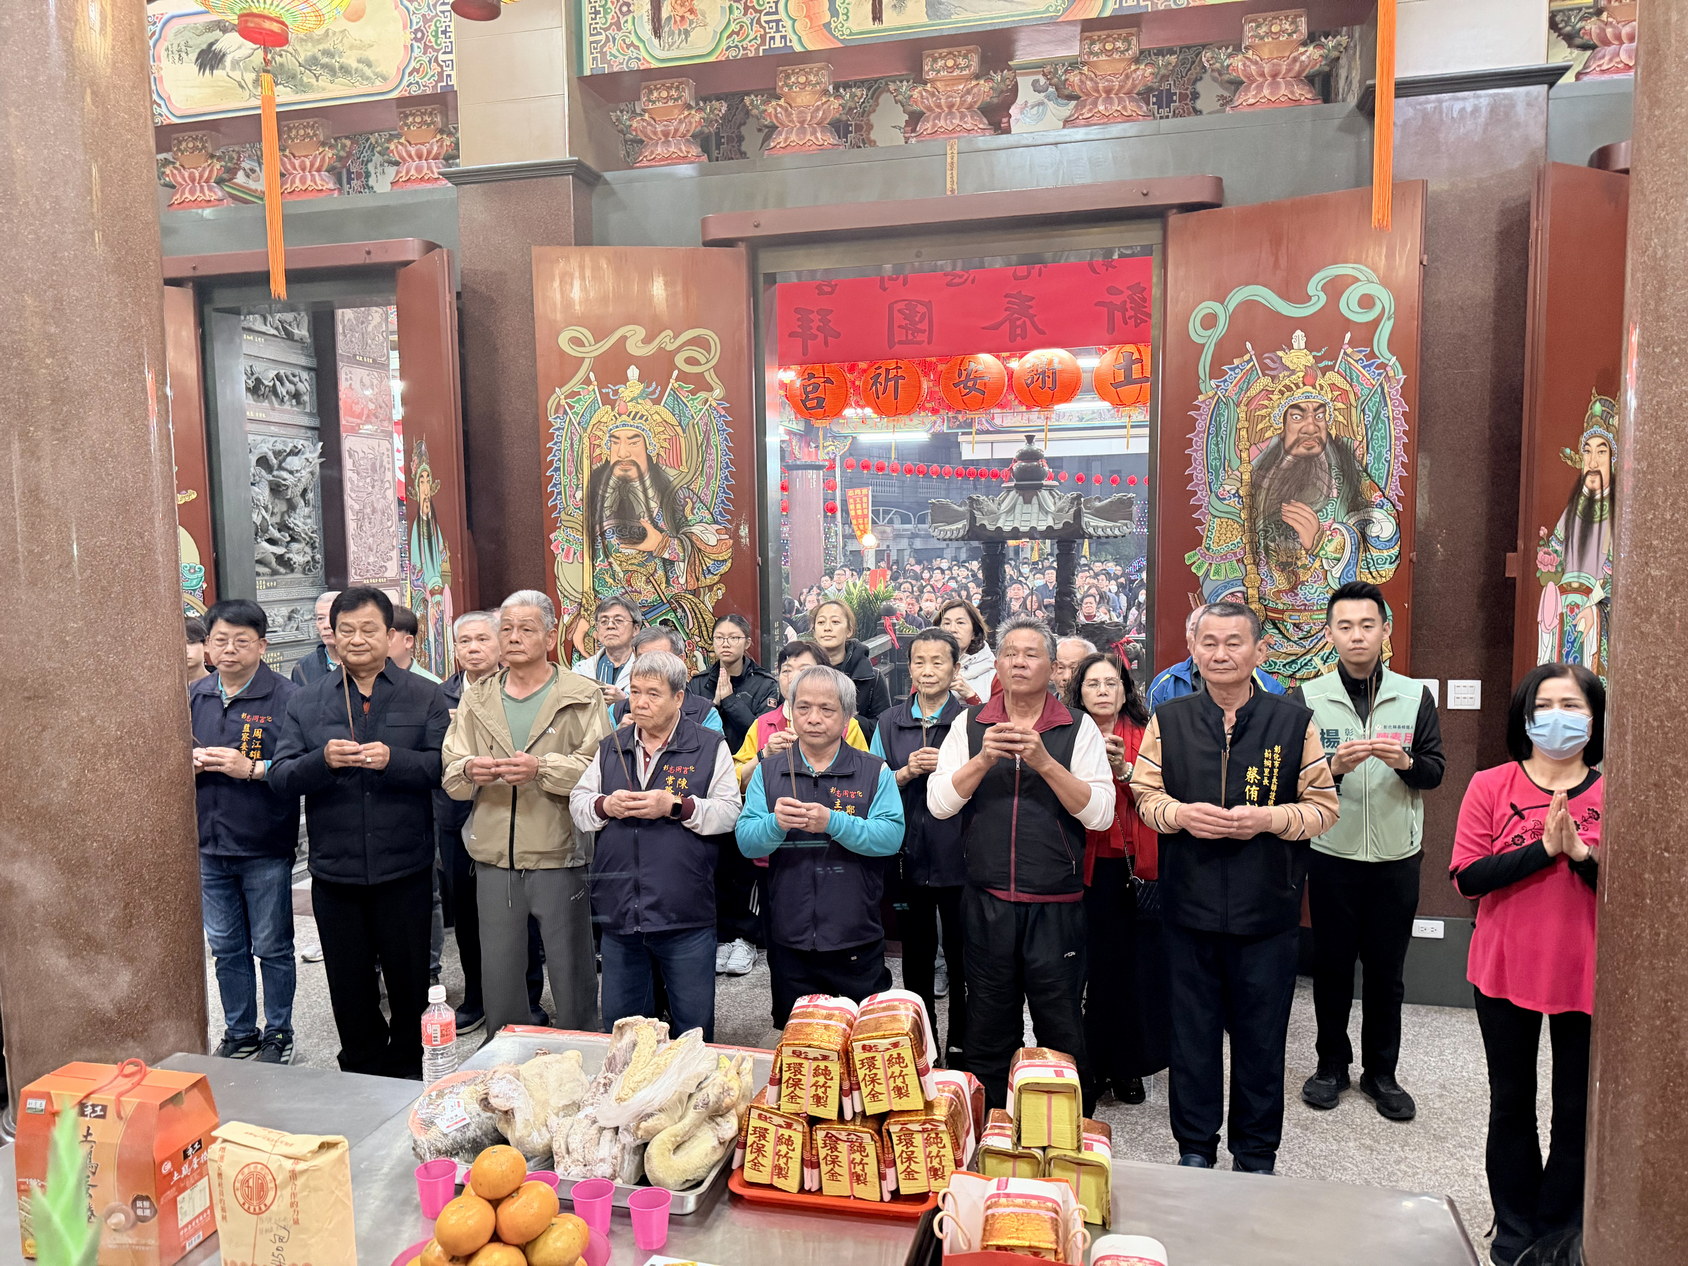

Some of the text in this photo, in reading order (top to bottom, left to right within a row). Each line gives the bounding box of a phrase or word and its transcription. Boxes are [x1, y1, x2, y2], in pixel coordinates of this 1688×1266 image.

[799, 372, 835, 411] 宮
[868, 365, 906, 400] 祈
[953, 360, 990, 397] 安
[1024, 355, 1062, 391] 謝
[1110, 351, 1151, 389] 土
[1245, 766, 1261, 807] 蔡侑
[783, 1061, 806, 1105] 環保金
[810, 1064, 834, 1109] 純竹製
[858, 1055, 885, 1103] 環保金
[886, 1053, 911, 1100] 純竹製
[747, 1125, 770, 1173] 環保金
[773, 1132, 796, 1180] 純竹製
[820, 1136, 844, 1182] 環保金
[849, 1139, 870, 1186] 純竹製
[895, 1132, 922, 1181] 環保金
[924, 1132, 947, 1181] 純竹製
